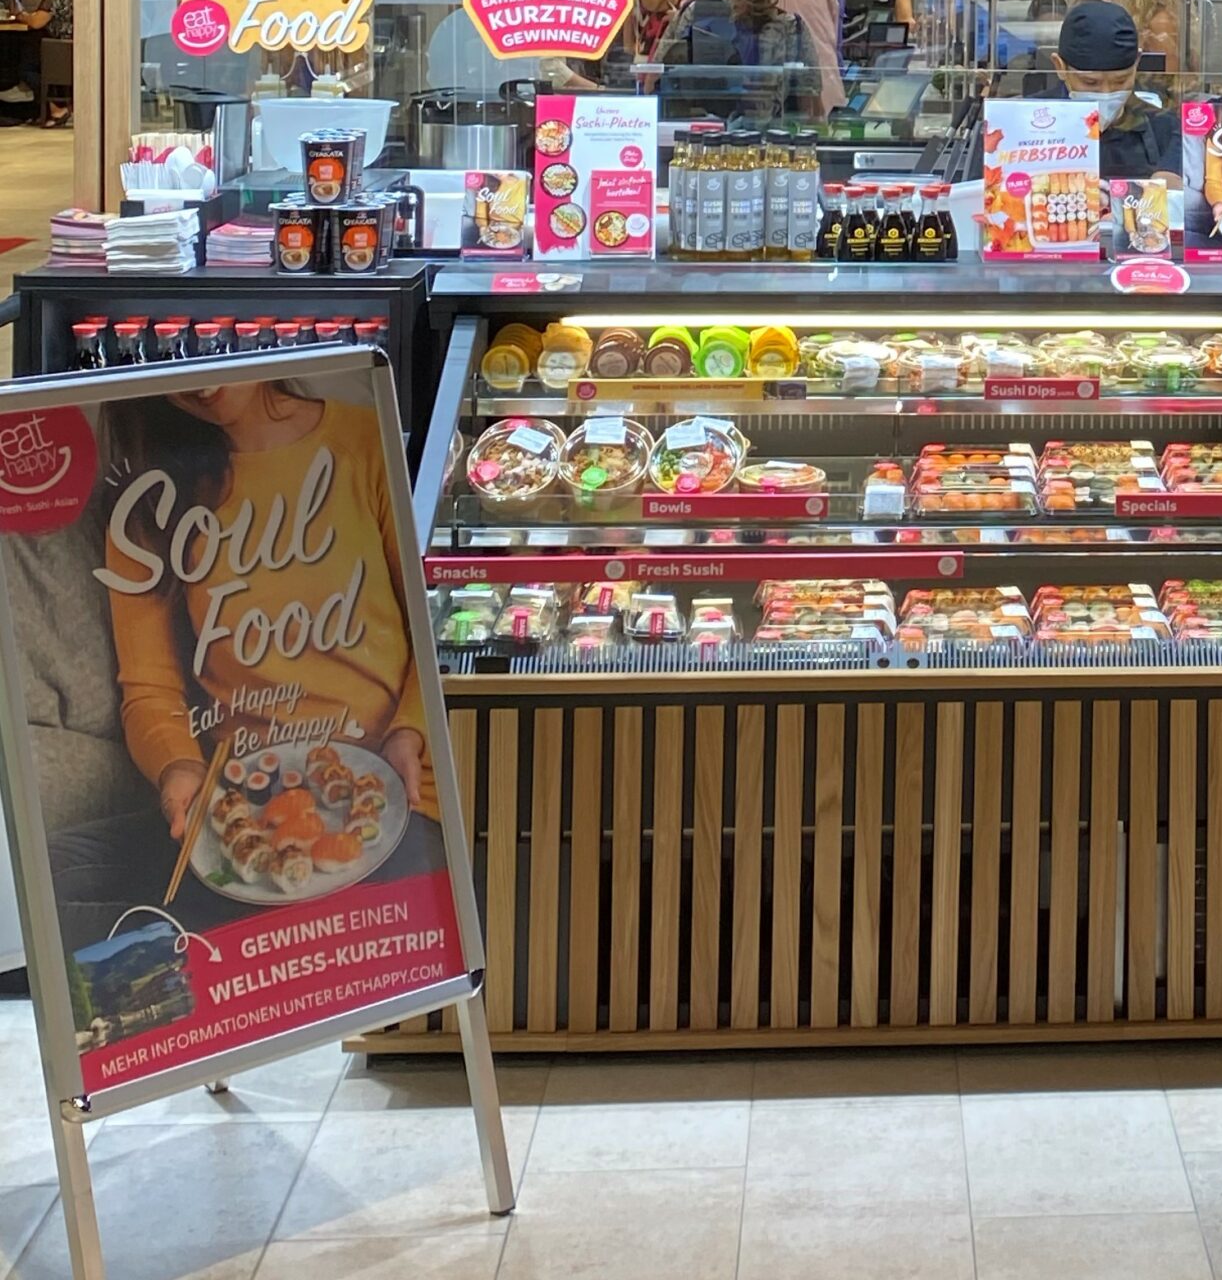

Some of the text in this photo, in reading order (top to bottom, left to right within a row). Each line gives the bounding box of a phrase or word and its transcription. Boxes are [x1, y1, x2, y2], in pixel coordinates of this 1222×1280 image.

[183, 6, 216, 28] eat
[488, 5, 612, 31] KURZTRIP
[185, 24, 217, 39] happy
[502, 29, 600, 48] GEWINNEN!
[575, 116, 651, 129] Sushi-Platten
[998, 144, 1089, 165] HERBSTBOX
[475, 187, 511, 202] Soul
[1122, 195, 1153, 210] Soul
[990, 384, 1057, 399] Sushi Dips
[0, 413, 54, 459] eat
[4, 447, 56, 477] happy
[26, 500, 50, 511] Sushi
[54, 497, 79, 507] Asian
[648, 500, 692, 514] Bowls
[1121, 499, 1177, 514] Specials
[92, 446, 336, 595] Soul
[432, 565, 488, 580] Snacks
[637, 561, 725, 577] Fresh Sushi
[193, 558, 364, 677] Food
[189, 699, 225, 738] Eat
[233, 707, 349, 758] Be happy!
[240, 902, 409, 959] GEWINNE EINEN
[209, 927, 446, 1005] WELLNESS-KURZTRIP!
[101, 963, 444, 1079] MEHR INFORMATIONEN UNTER EATHAPPY.COM
